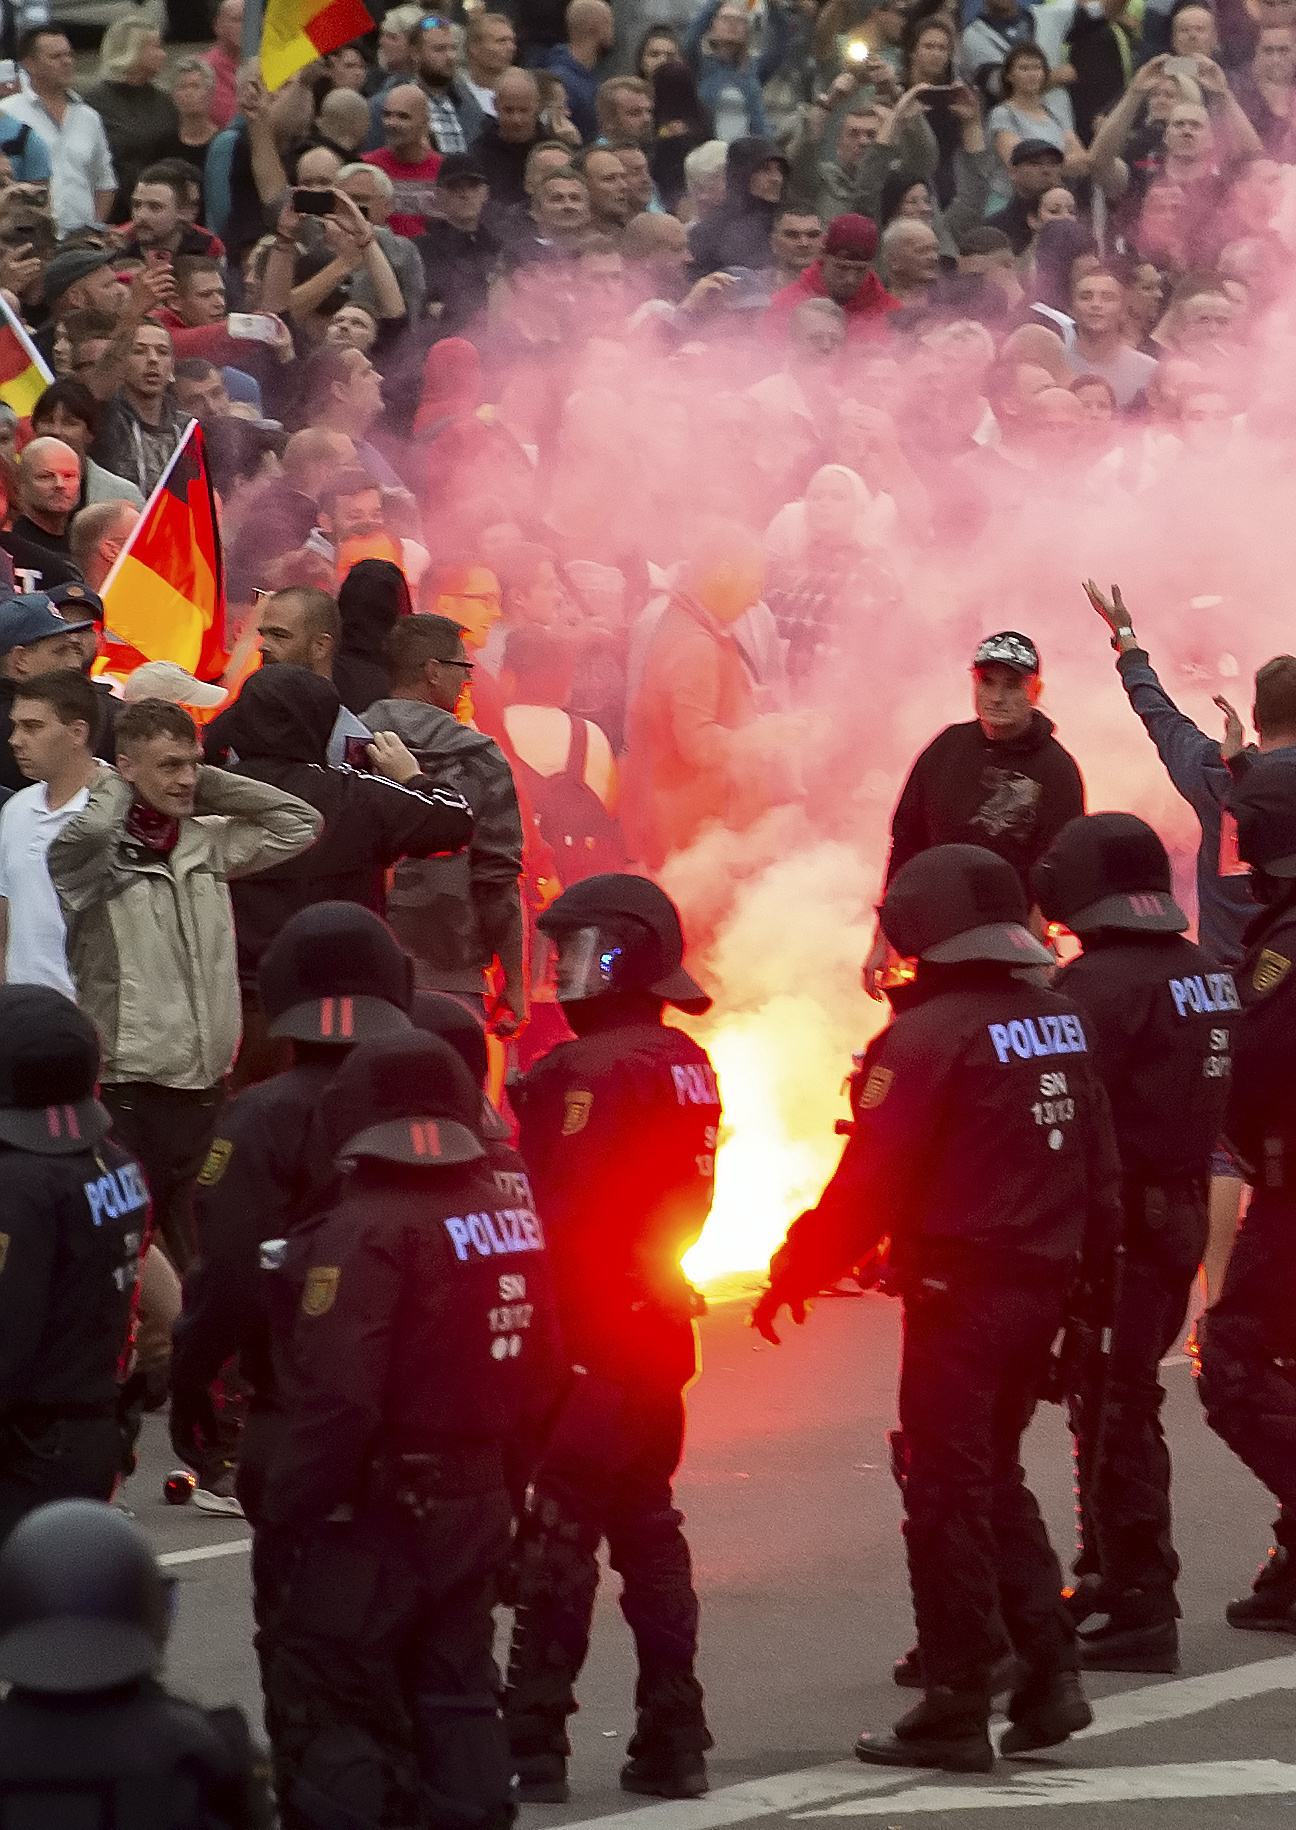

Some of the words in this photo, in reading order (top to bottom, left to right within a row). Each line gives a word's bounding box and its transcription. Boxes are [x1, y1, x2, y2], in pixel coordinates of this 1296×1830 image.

[987, 1014, 1088, 1063] POLIZEI
[1039, 1071, 1068, 1097] SN
[443, 1208, 546, 1262] POLIZEI
